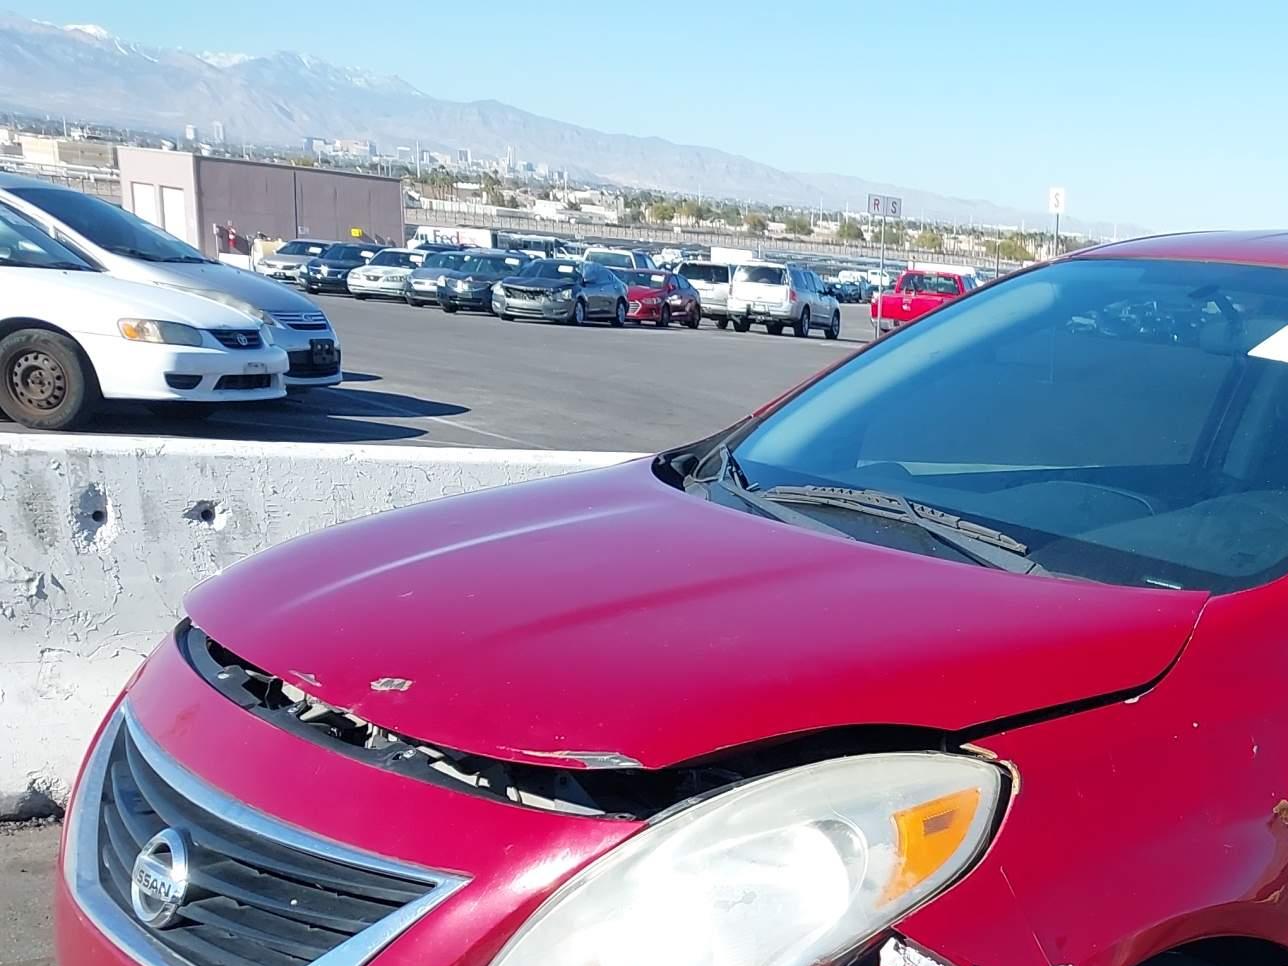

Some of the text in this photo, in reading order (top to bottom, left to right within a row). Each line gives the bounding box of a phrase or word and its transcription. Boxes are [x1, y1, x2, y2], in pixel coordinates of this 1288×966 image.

[873, 198, 880, 211] R
[891, 201, 898, 214] S
[1054, 193, 1061, 209] S
[136, 869, 173, 898] SSAN
